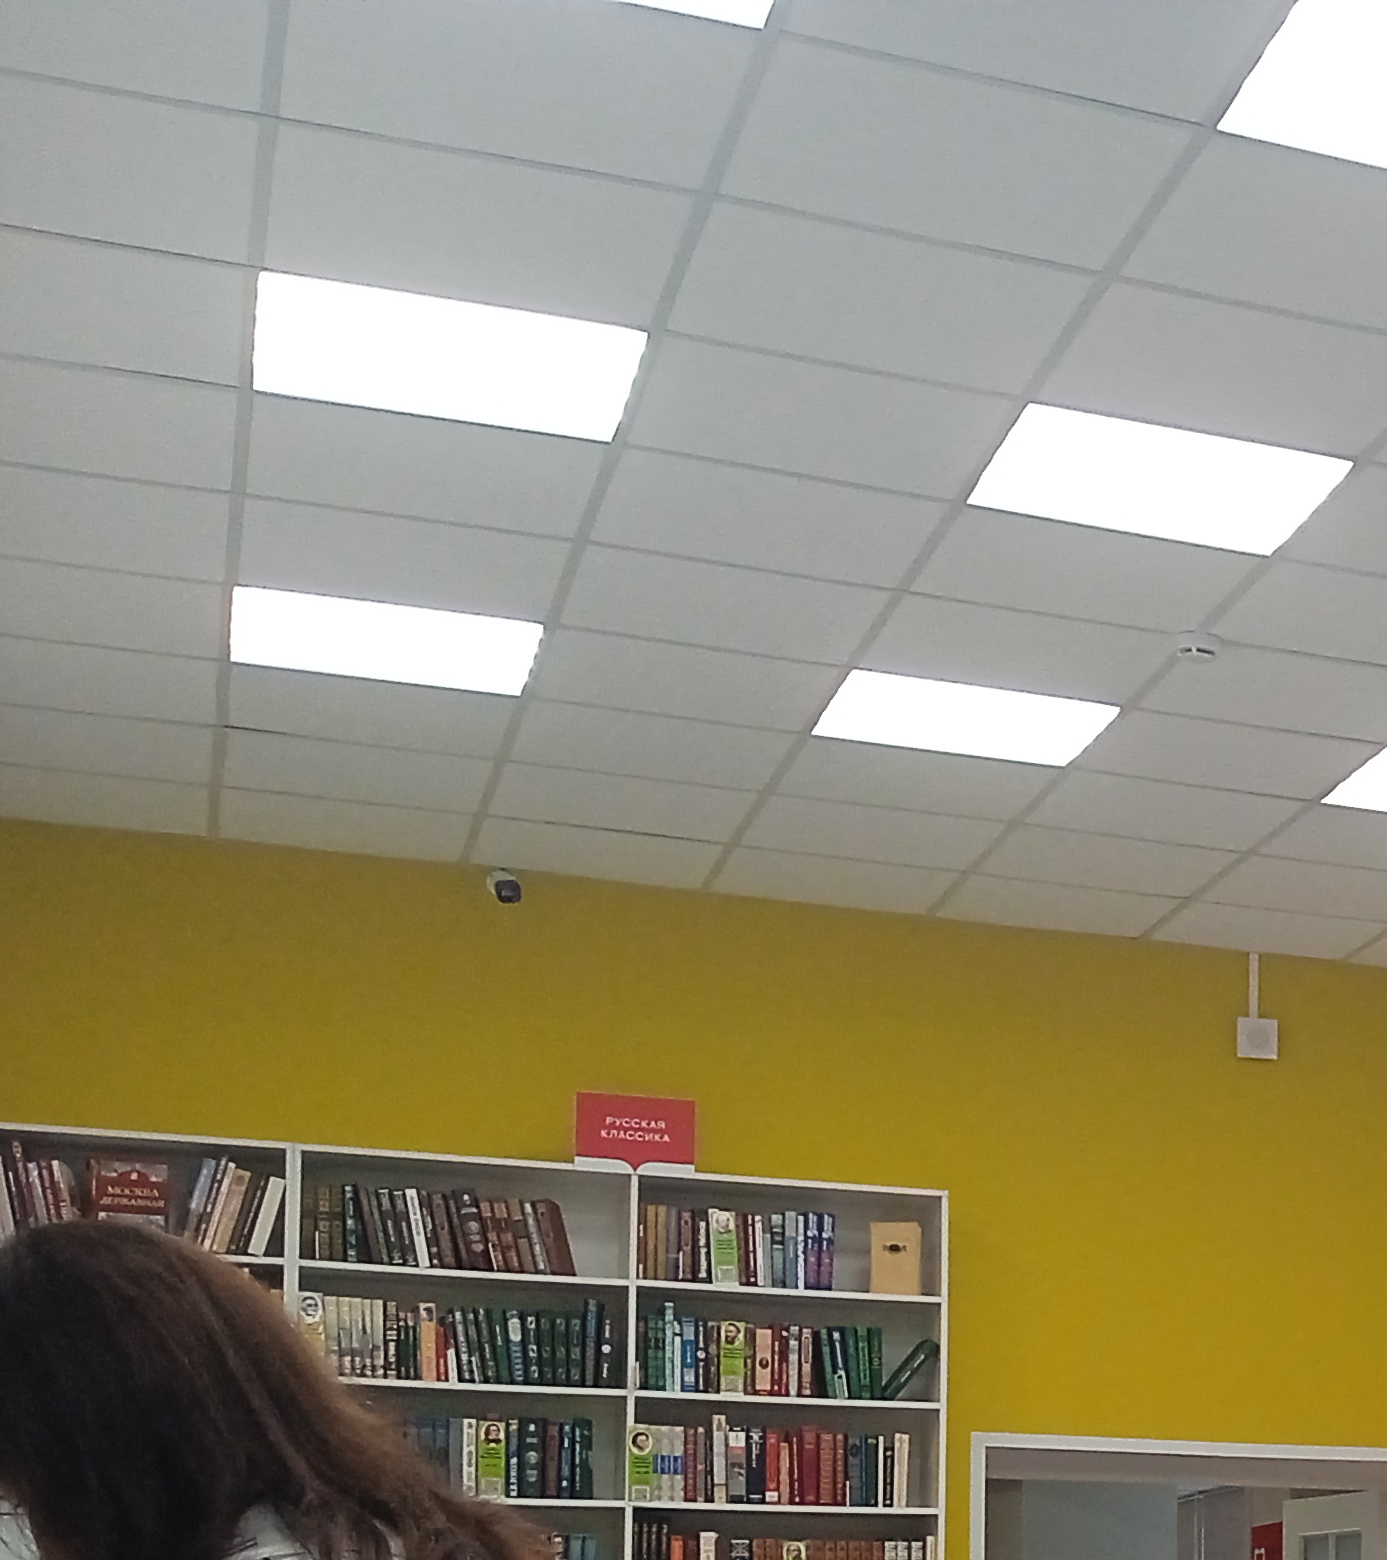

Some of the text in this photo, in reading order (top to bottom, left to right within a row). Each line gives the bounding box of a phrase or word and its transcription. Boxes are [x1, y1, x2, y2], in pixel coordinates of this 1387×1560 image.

[605, 1116, 666, 1129] РУССКАЯ
[600, 1129, 670, 1143] КЛАССИКА
[106, 1185, 159, 1198] МОСКВА
